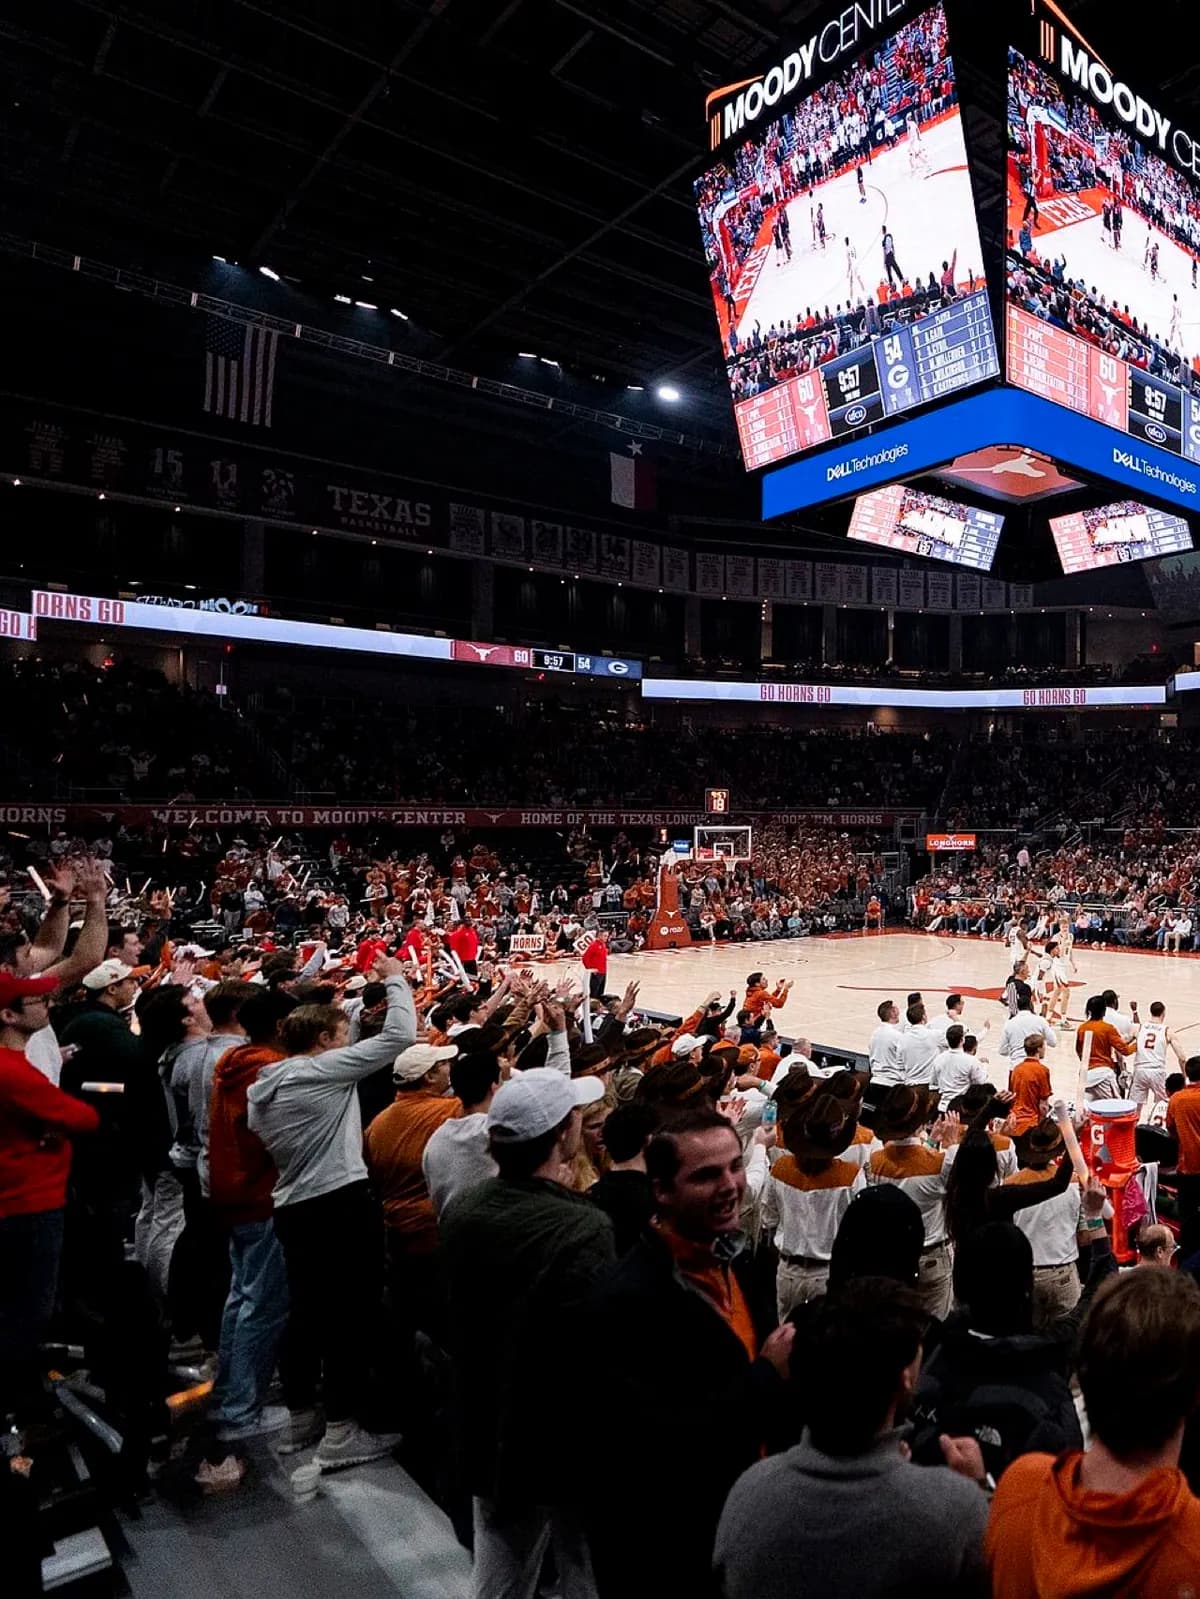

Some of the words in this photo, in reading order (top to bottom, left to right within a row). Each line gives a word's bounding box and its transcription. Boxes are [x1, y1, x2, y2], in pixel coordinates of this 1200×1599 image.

[725, 35, 817, 139] MOODY
[818, 0, 905, 62] CENT
[1061, 36, 1171, 149] MOODY
[883, 335, 903, 365] 54
[838, 364, 860, 392] 9:57
[1099, 354, 1117, 383] 60
[797, 375, 814, 403] 60
[1144, 385, 1166, 412] 9:57
[851, 443, 908, 475] Technologies
[1141, 457, 1197, 495] Technologies
[327, 485, 432, 527] TEXAS
[98, 600, 124, 624] GO
[514, 650, 528, 664] 60
[544, 653, 564, 667] 9:57
[578, 657, 591, 671] 54
[760, 684, 775, 701] GO
[778, 685, 814, 702] HORNS
[816, 687, 831, 703] GO
[1023, 691, 1036, 705] GO
[1038, 689, 1070, 704] HORNS
[1073, 688, 1086, 704] GO
[151, 808, 268, 825] WELCOME
[276, 810, 304, 824] TO
[391, 811, 466, 825] CENTER
[521, 813, 563, 825] HOME
[566, 813, 584, 824] OF
[588, 813, 616, 825] THE
[619, 813, 661, 825] TEXAS
[840, 814, 883, 825] HORNS
[512, 937, 542, 949] HORNS
[577, 934, 593, 951] GO
[1144, 1033, 1156, 1050] 2
[1091, 1124, 1104, 1145] G
